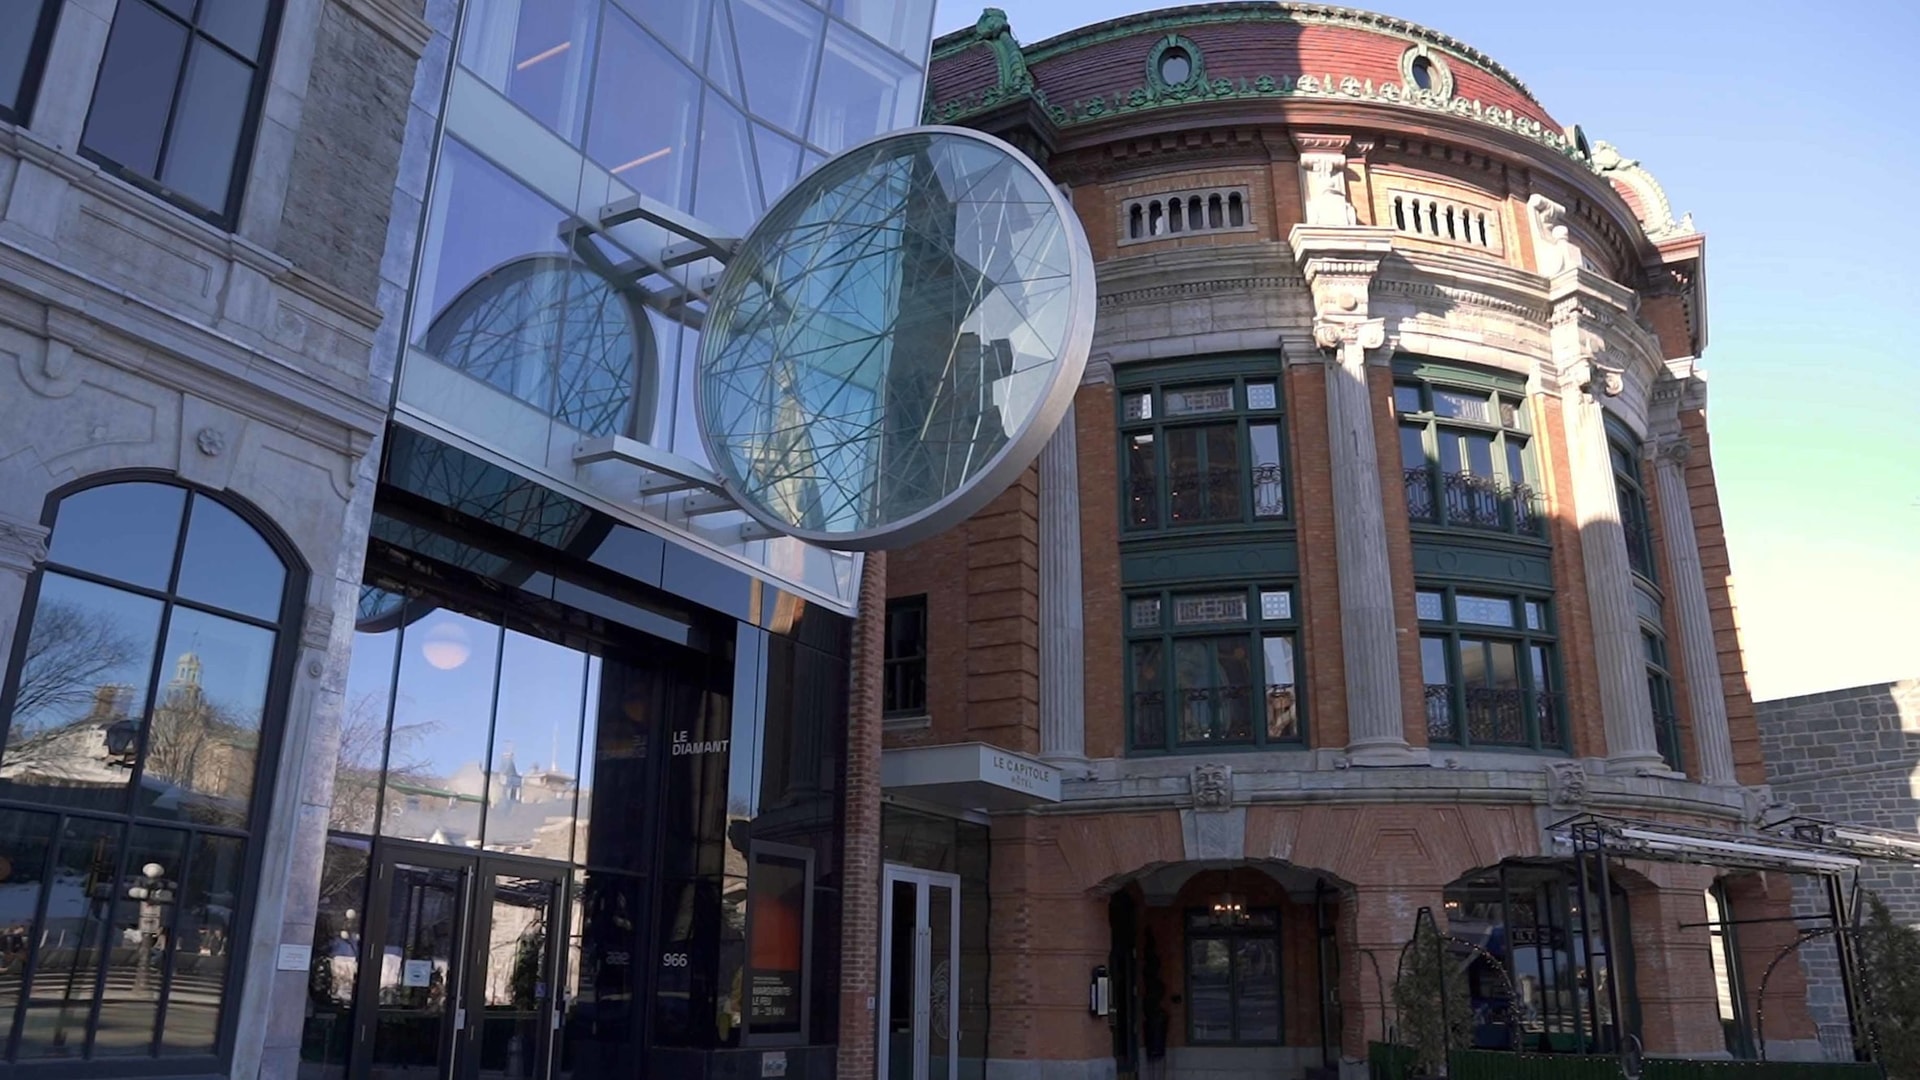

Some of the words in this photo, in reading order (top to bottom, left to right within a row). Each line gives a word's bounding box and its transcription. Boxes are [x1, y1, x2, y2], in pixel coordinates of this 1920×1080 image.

[673, 730, 688, 743] LE
[672, 740, 729, 755] DIAMANT
[993, 756, 1004, 769] LE
[1006, 760, 1049, 782] CAPITOLE
[662, 953, 688, 967] 966
